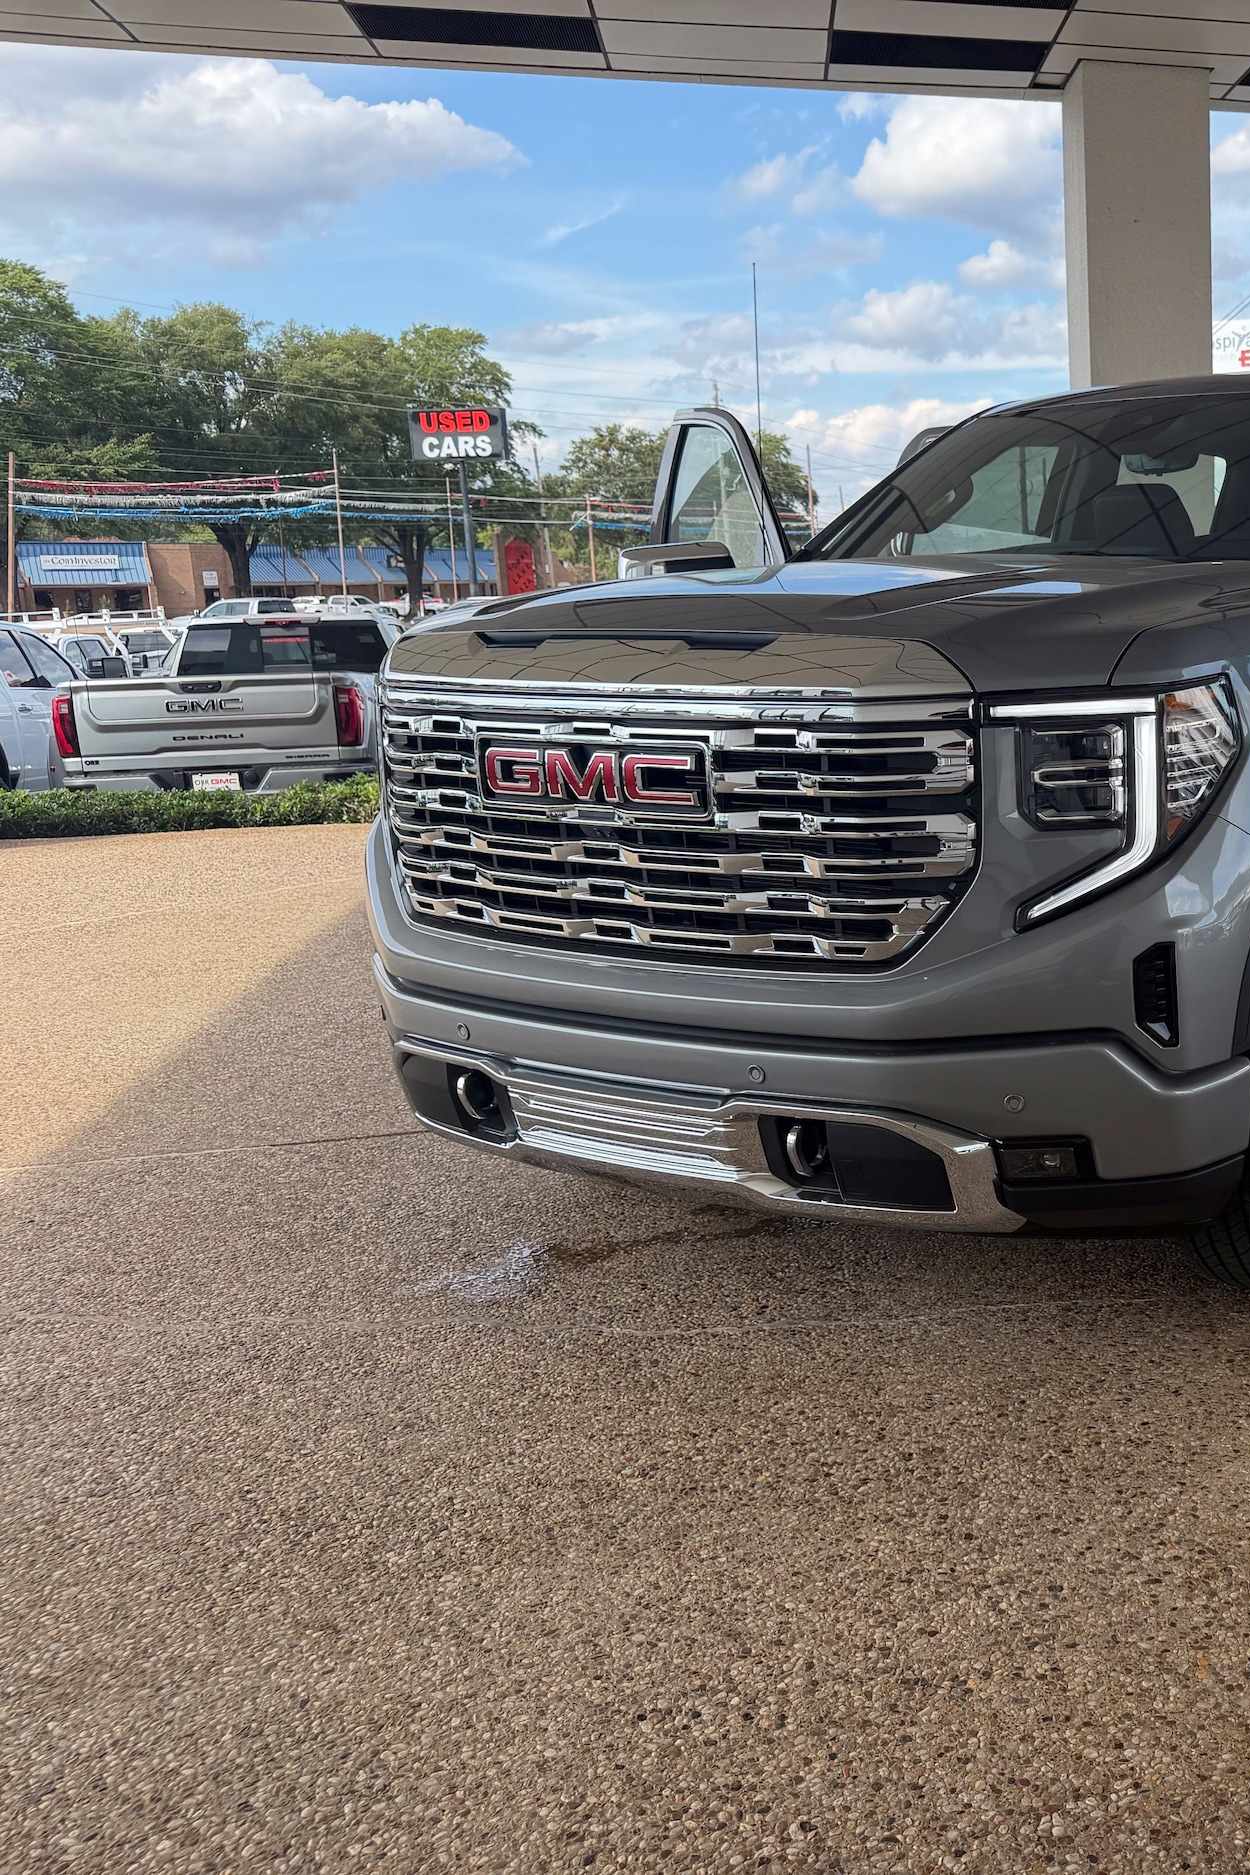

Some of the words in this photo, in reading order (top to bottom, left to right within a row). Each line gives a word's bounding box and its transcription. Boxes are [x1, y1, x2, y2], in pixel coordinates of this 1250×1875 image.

[419, 411, 490, 434] USED
[422, 435, 493, 458] CARS
[165, 698, 244, 713] GMC
[172, 733, 244, 741] DENALI
[486, 748, 701, 806] GMC
